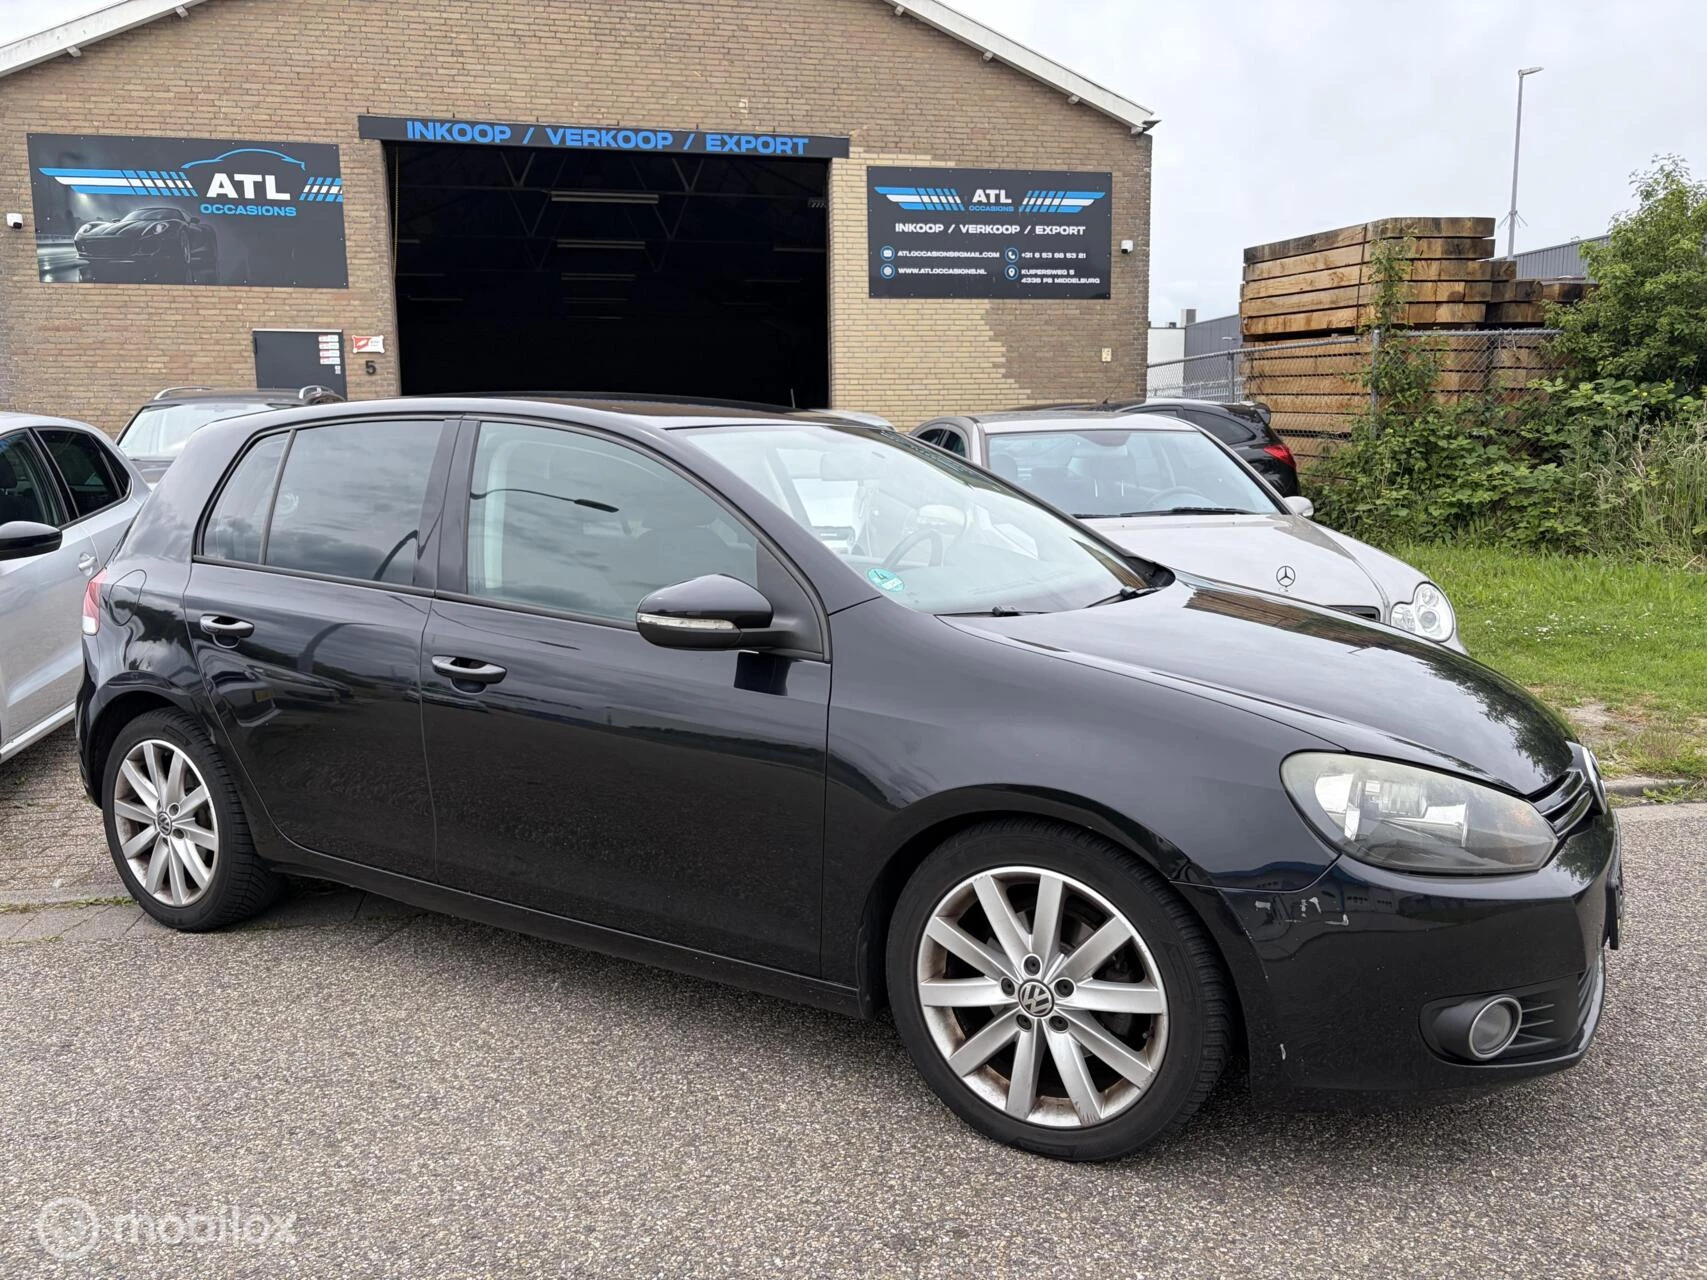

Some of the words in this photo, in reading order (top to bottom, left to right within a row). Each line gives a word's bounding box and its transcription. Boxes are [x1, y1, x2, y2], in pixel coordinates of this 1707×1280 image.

[405, 120, 511, 144] INKOOP
[522, 126, 534, 146] /
[544, 126, 674, 150] VERKOOP
[683, 132, 695, 151] /
[705, 132, 809, 155] EXPORT
[206, 172, 291, 201] ATL
[971, 188, 1012, 204] ATL
[200, 203, 297, 217] OCCASIONS
[968, 204, 1014, 213] OCCASIONS
[895, 222, 944, 234] INKOOP
[948, 223, 955, 234] /
[959, 223, 1020, 235] VERKOOP
[1024, 225, 1031, 235] /
[1035, 225, 1086, 236] EXPORT
[898, 267, 987, 275] WWW.ATLOCCASIONS.NL
[365, 360, 377, 375] 5
